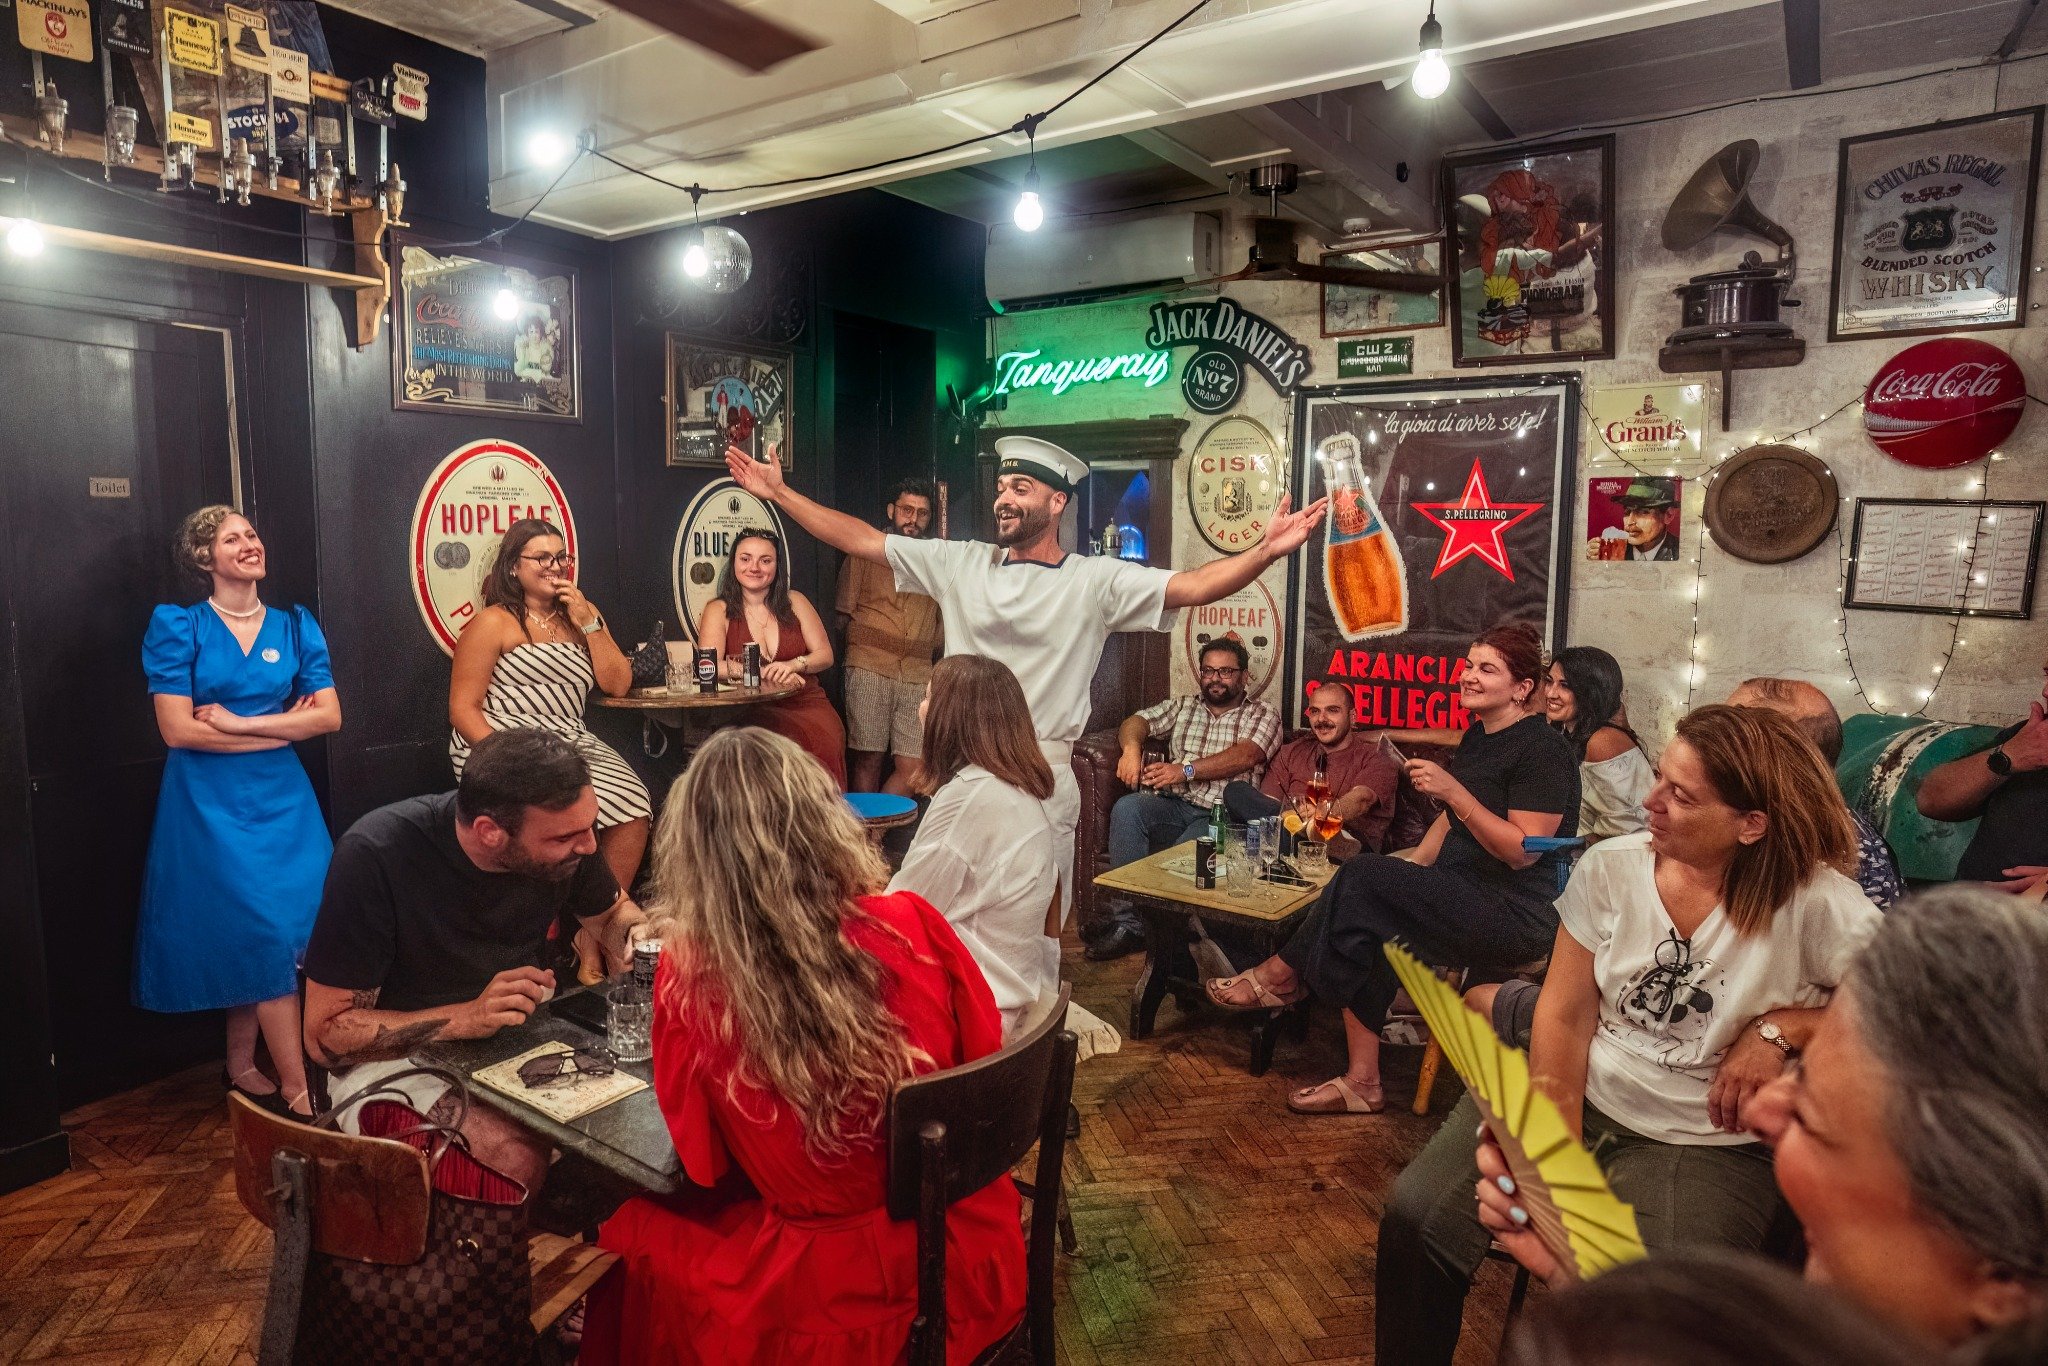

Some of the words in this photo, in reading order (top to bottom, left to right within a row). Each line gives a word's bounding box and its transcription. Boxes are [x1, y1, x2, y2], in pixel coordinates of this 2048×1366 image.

[175, 36, 211, 53] Hennessy
[174, 123, 208, 138] Hennessy
[1864, 156, 1940, 200] CHIVAS
[1943, 154, 2006, 187] REGAL
[1861, 255, 1929, 272] BLENDED
[1933, 241, 1997, 266] SCOTCH
[1861, 265, 1994, 300] WHISKY
[415, 328, 469, 350] RELIEVES
[1149, 307, 1211, 347] JACK
[1212, 301, 1306, 388] DANIEL'S
[435, 363, 447, 377] IN
[449, 365, 470, 379] THE
[471, 368, 514, 384] WORLD
[995, 348, 1169, 395] Tanqueray
[1208, 359, 1227, 371] OLD
[1195, 388, 1221, 402] BRAND
[1873, 363, 2008, 403] Coca-Cola
[1385, 411, 1399, 434] la
[1399, 413, 1436, 444] gioia
[1437, 412, 1458, 433] di
[1456, 412, 1497, 433] aver
[1606, 419, 1687, 443] Grant's
[1200, 454, 1271, 474] CISK
[93, 482, 126, 493] Toilet
[441, 502, 553, 535] HOPLEAF
[1445, 509, 1507, 520] S.PELLEGRINO
[693, 531, 730, 557] BLUE
[1206, 520, 1263, 544] LAGER
[1198, 606, 1267, 628] HOPLEAF
